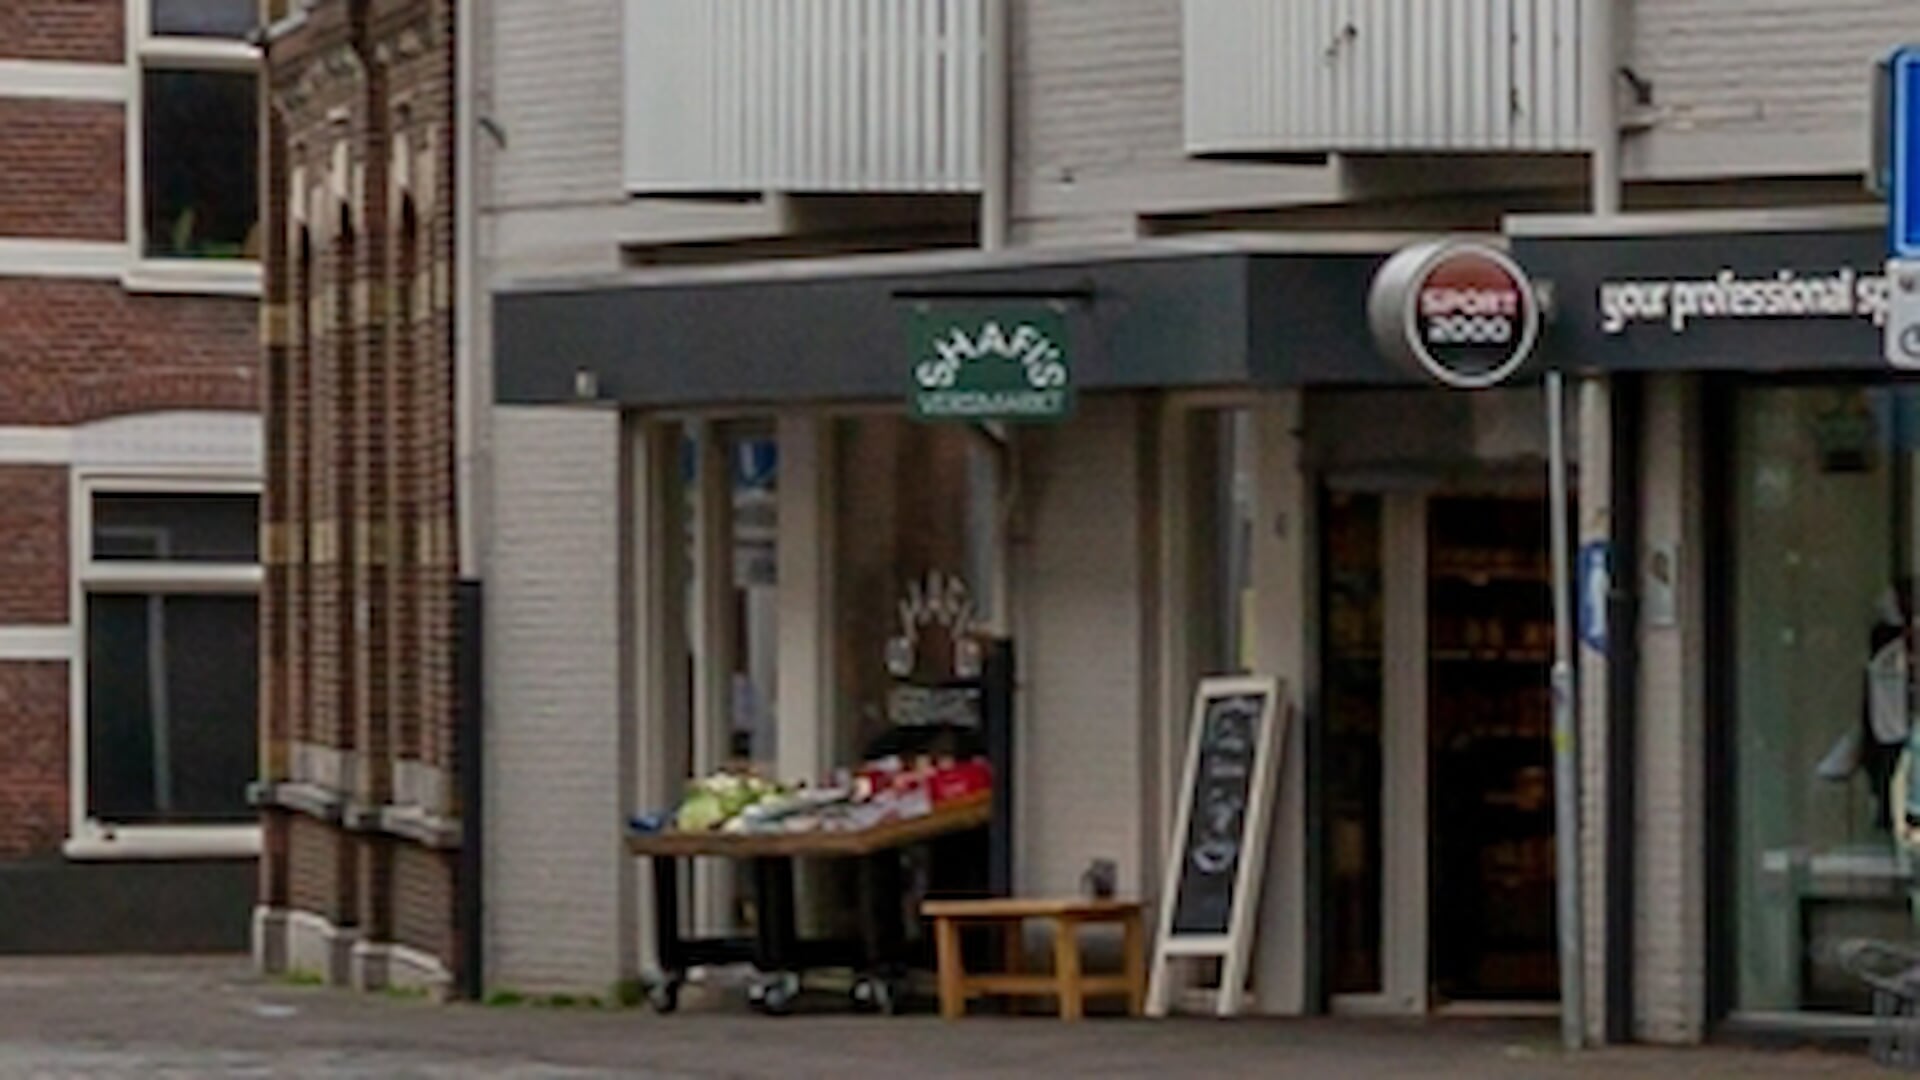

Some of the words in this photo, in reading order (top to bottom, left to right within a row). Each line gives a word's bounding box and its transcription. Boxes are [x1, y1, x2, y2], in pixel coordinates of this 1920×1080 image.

[1421, 286, 1518, 316] SPORT
[1601, 280, 1669, 332] your
[1671, 268, 1853, 331] professional
[1427, 315, 1512, 344] 2000
